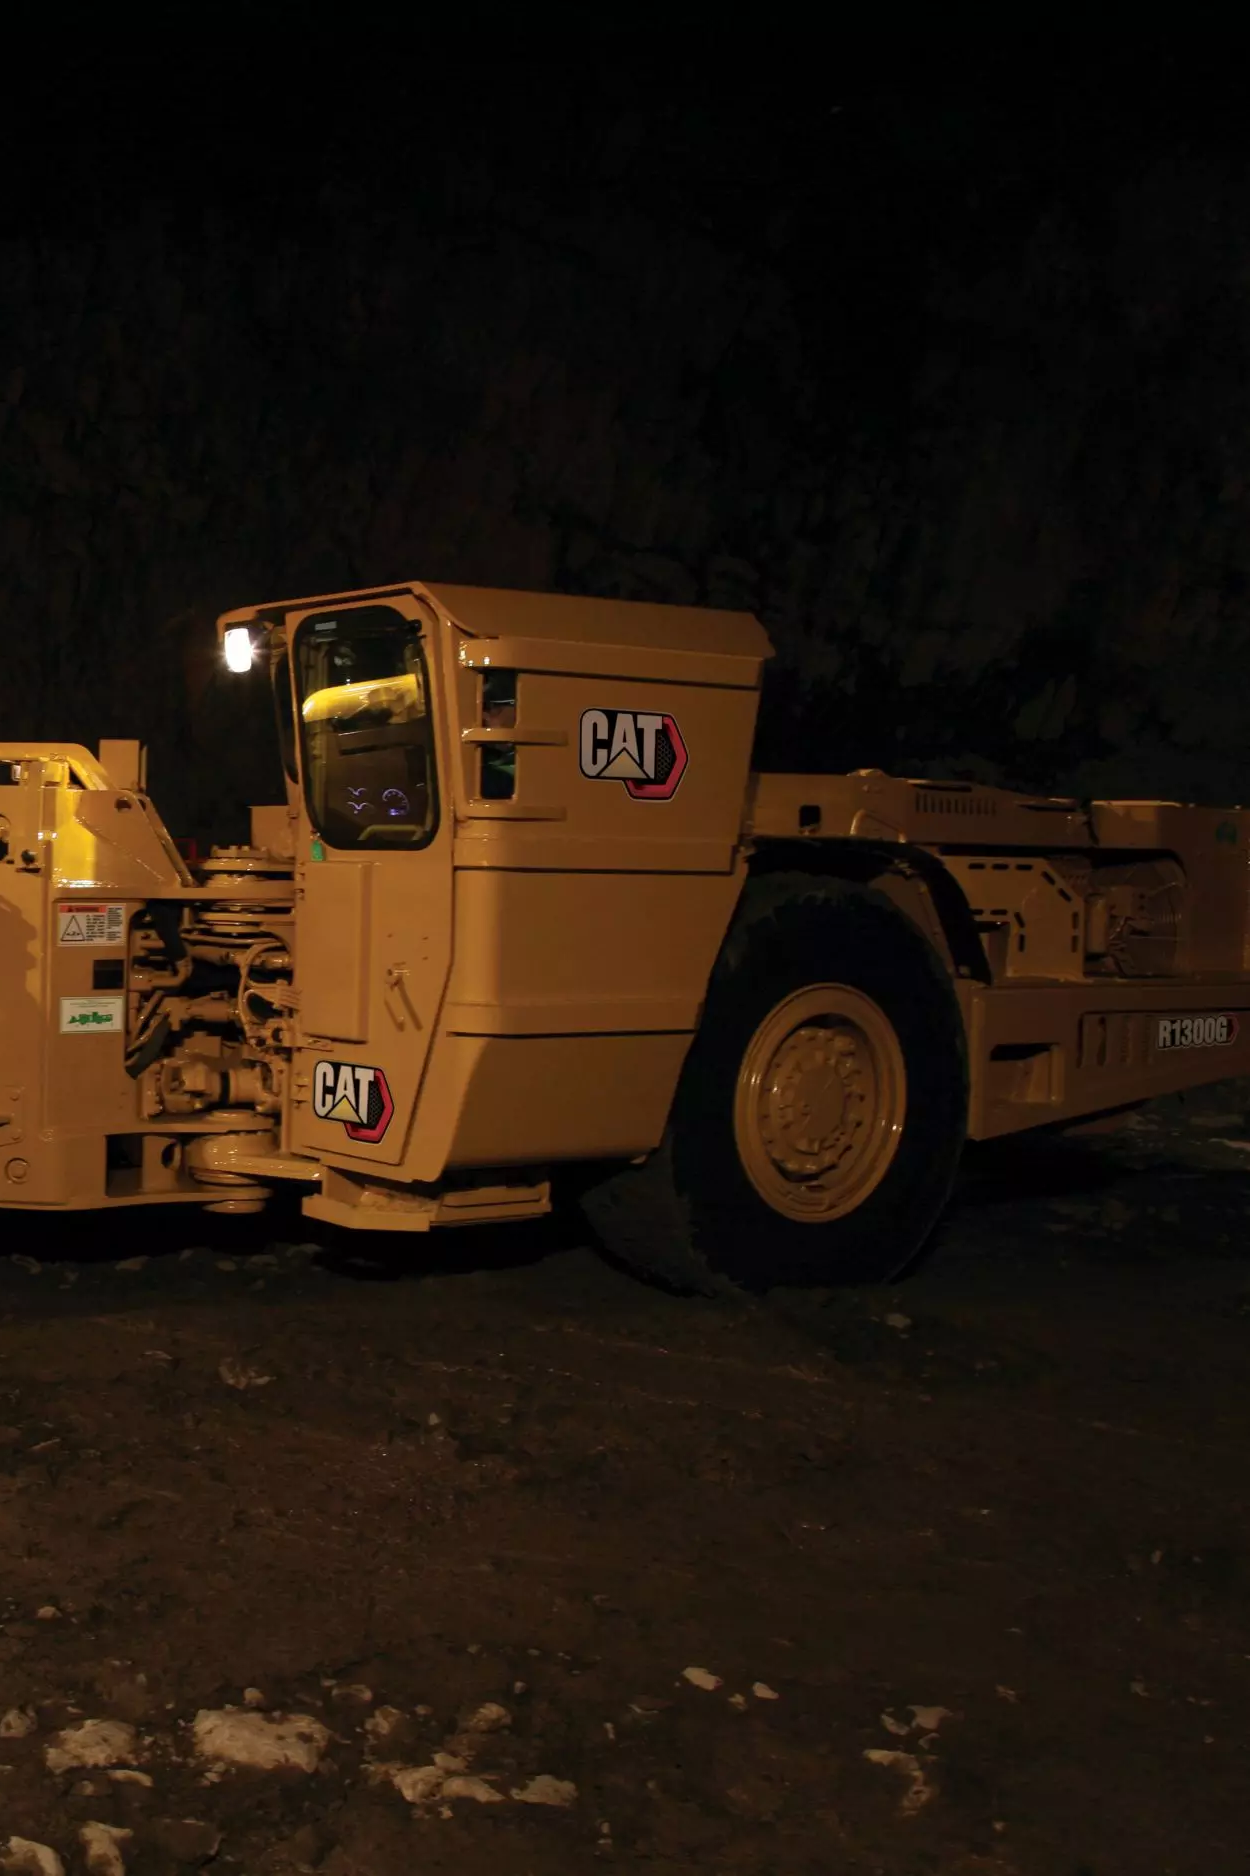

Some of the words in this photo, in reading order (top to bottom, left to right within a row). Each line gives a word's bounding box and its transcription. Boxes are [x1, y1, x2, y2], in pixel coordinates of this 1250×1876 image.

[581, 709, 662, 779] CAT
[1158, 1016, 1228, 1048] R1300G
[315, 1061, 375, 1124] CAT
